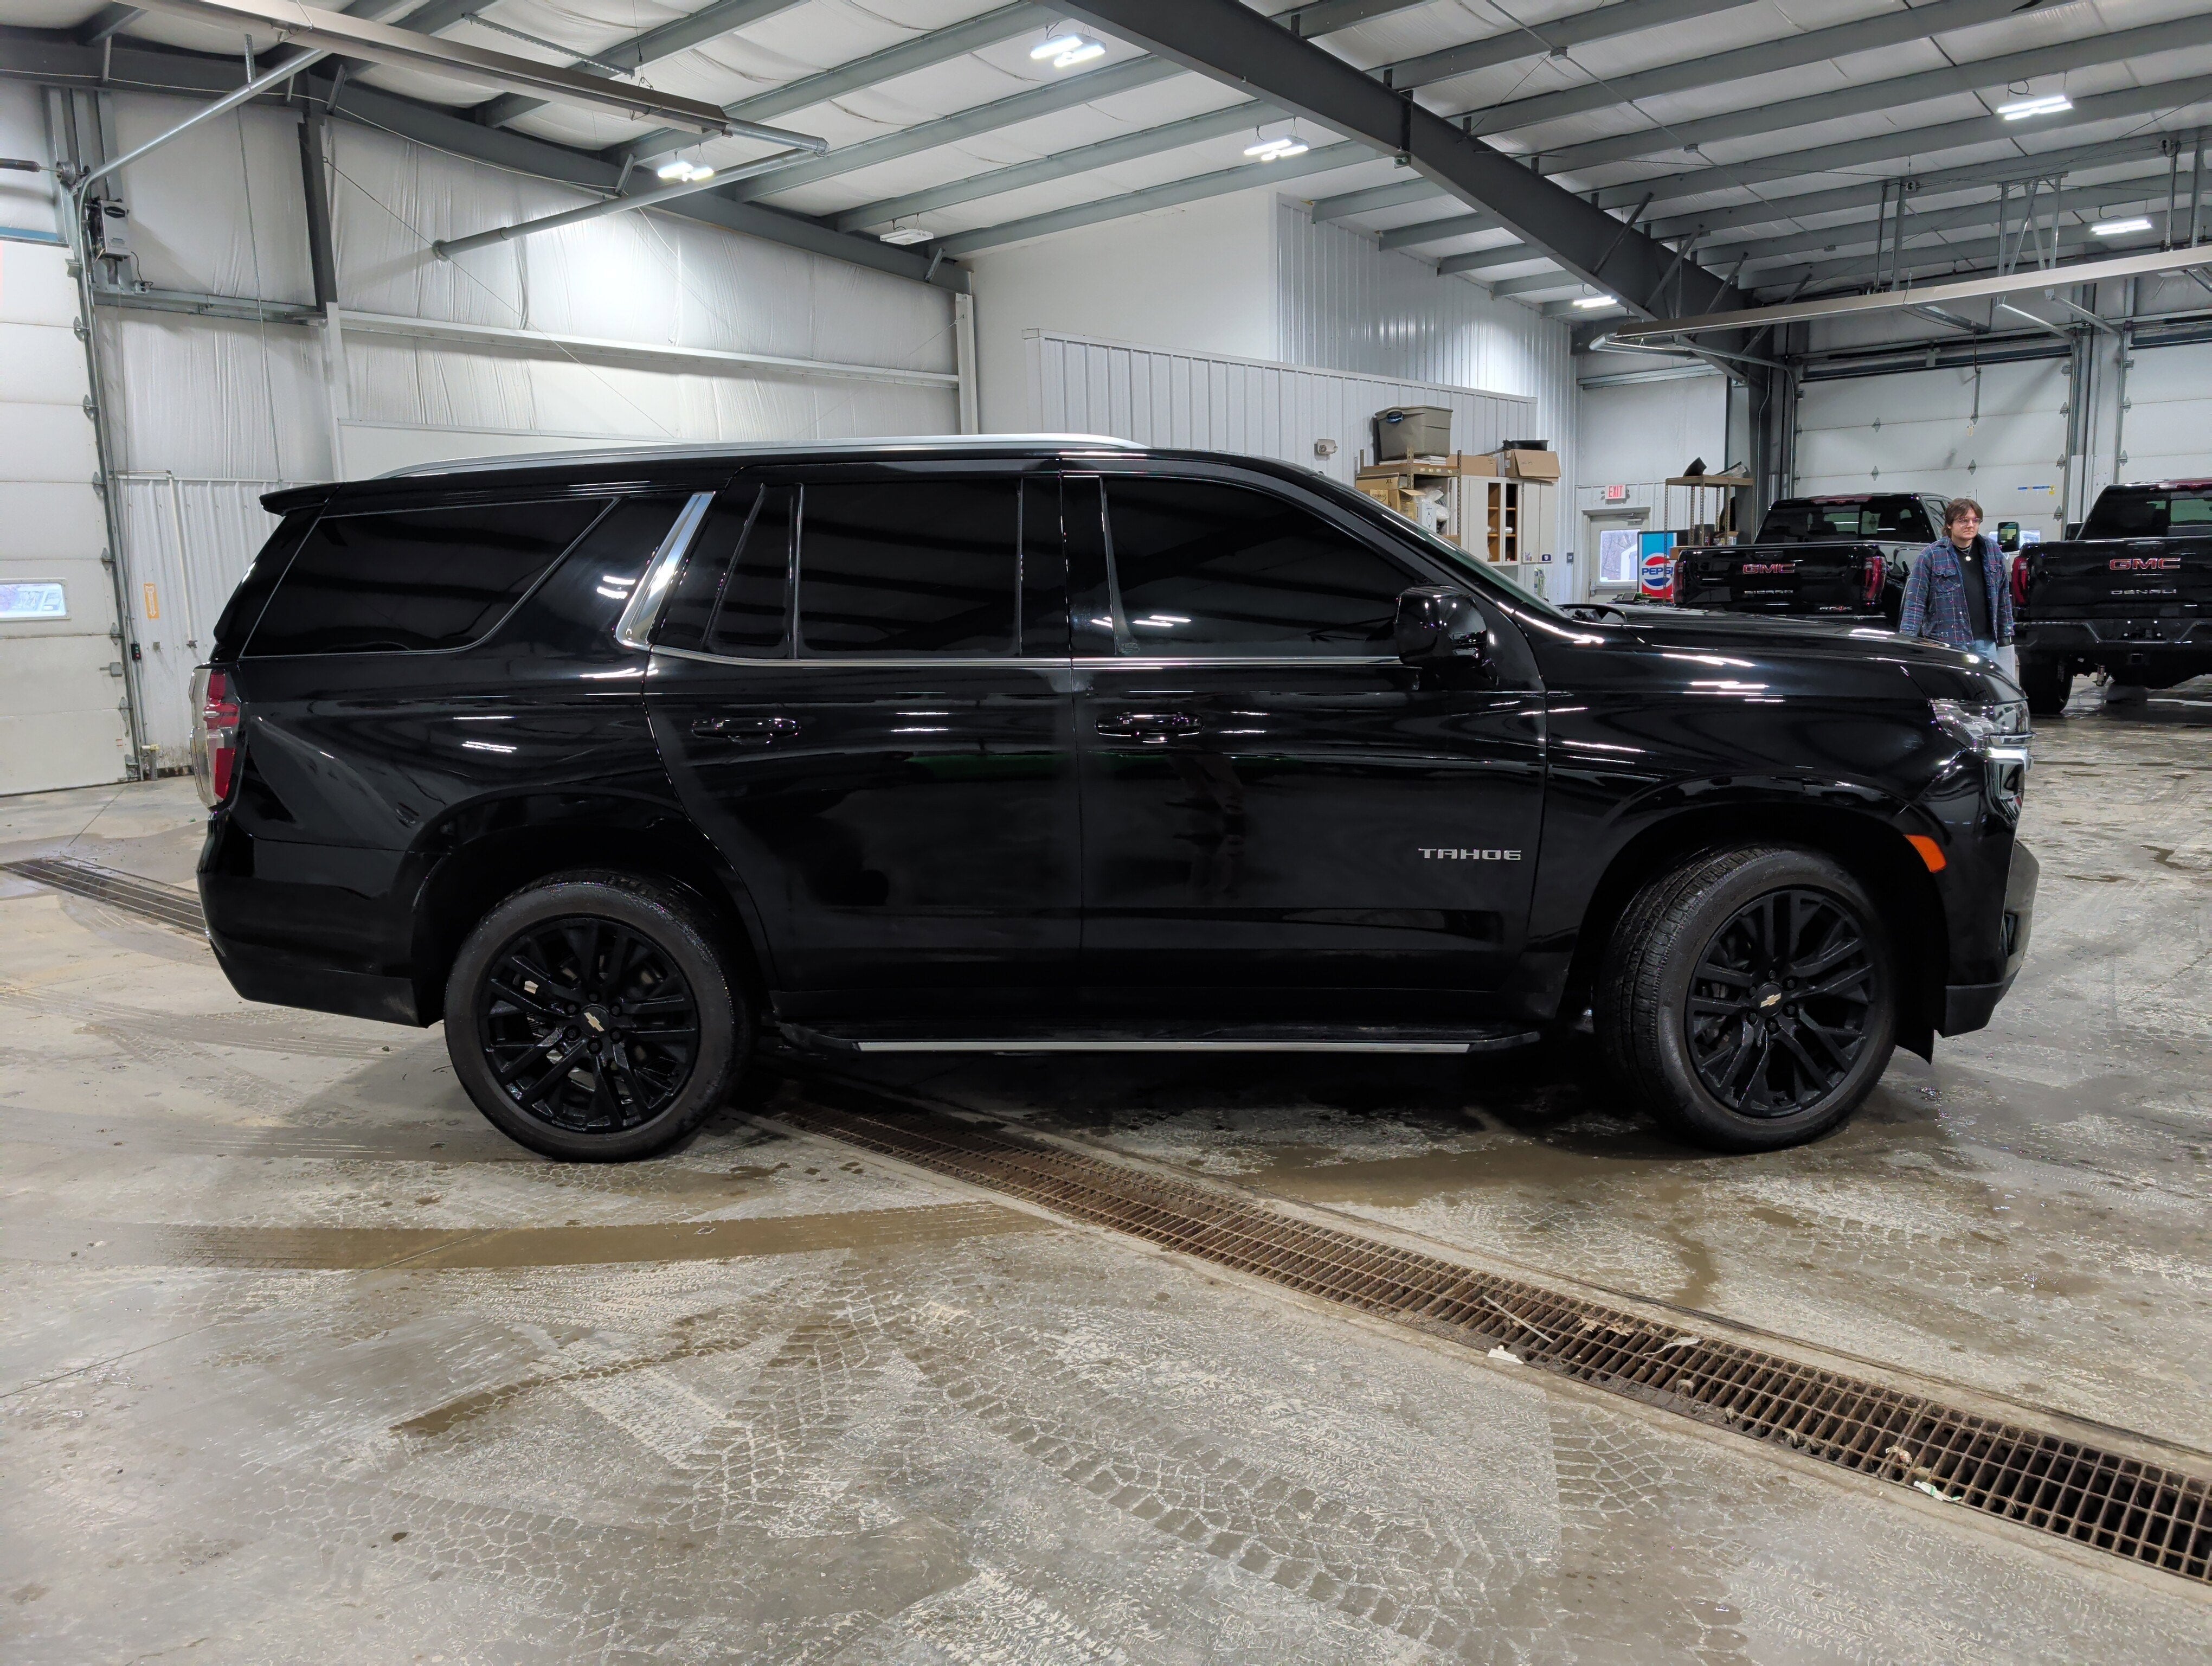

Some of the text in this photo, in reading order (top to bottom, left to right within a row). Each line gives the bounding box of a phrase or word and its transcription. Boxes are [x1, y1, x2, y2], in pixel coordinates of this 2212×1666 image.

[1609, 485, 1623, 497] EXIT
[1742, 563, 1795, 574] GMC
[2110, 558, 2181, 570] GMC
[1642, 567, 1674, 576] PEPSI
[1418, 848, 1521, 860] TAHOE
